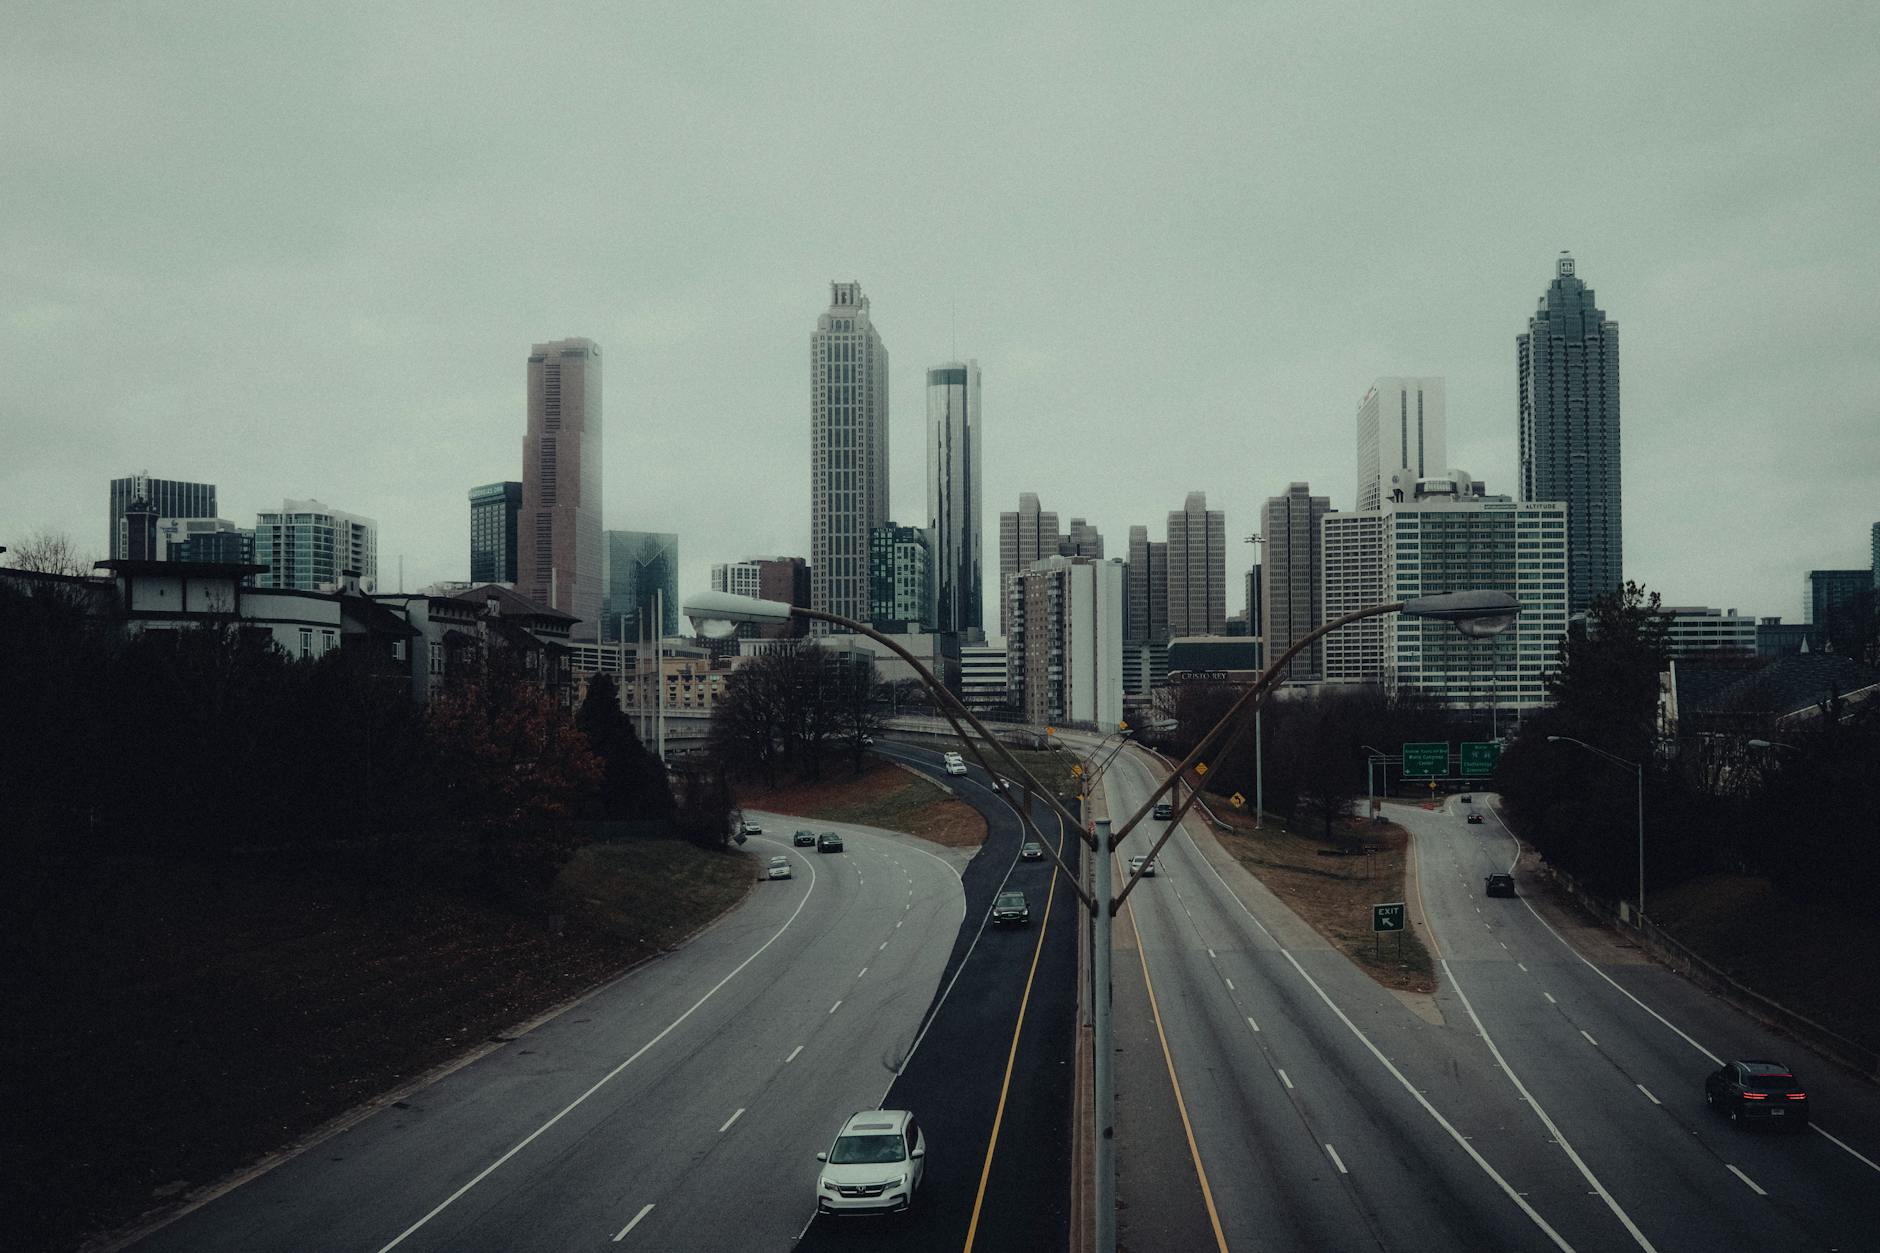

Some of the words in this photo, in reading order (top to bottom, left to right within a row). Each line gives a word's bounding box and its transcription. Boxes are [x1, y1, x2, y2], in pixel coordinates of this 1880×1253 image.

[1181, 672, 1209, 680] CRISTO
[1212, 672, 1227, 680] REY
[1378, 907, 1399, 915] EXIT
